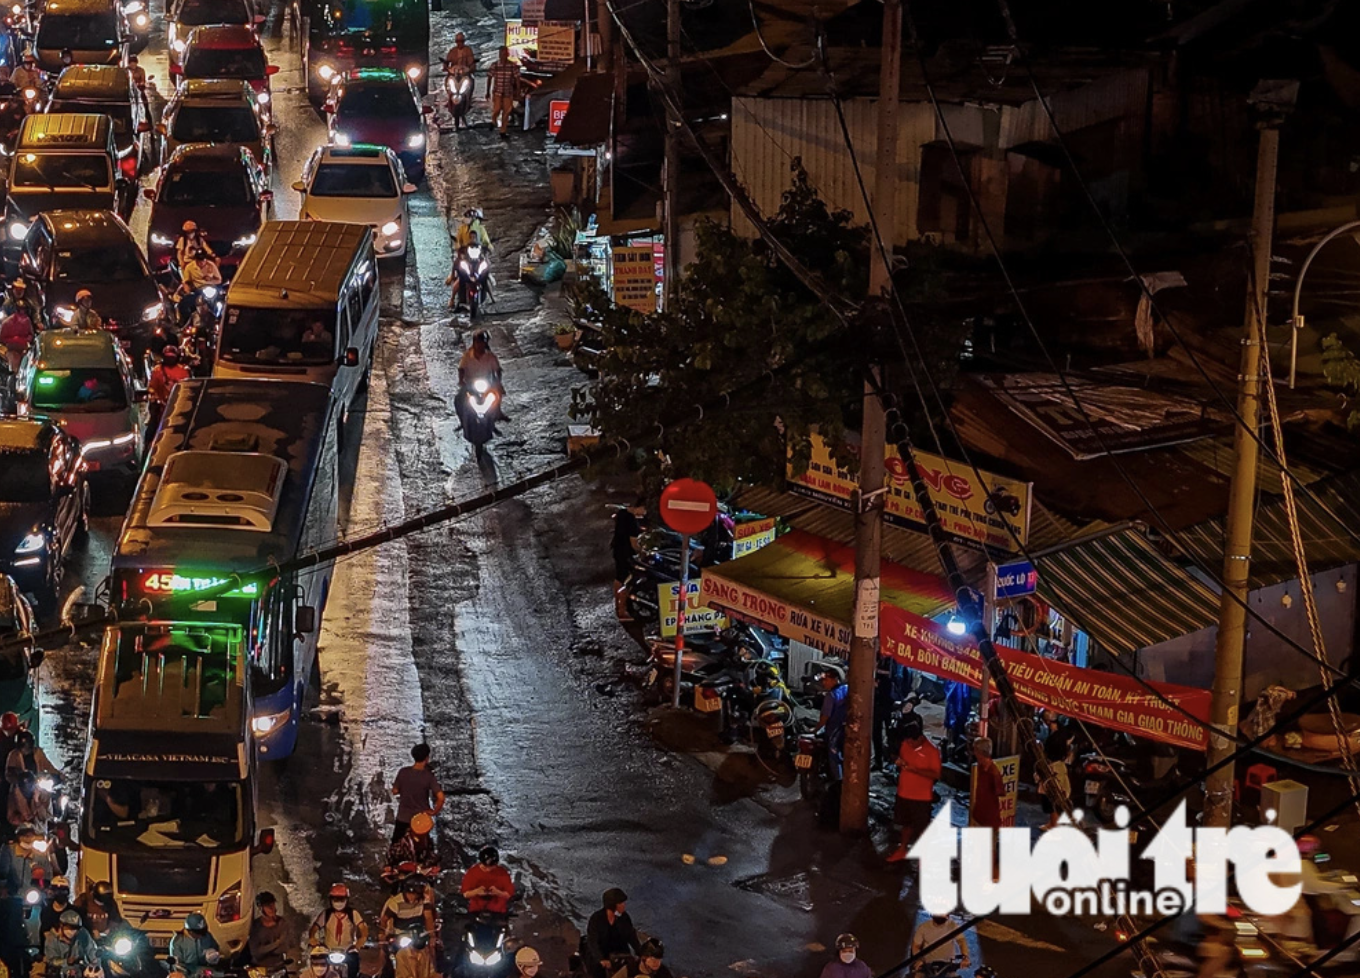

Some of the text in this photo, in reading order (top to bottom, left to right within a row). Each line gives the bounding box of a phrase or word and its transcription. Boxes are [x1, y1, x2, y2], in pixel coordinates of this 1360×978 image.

[144, 573, 173, 590] 45
[702, 577, 739, 604] SANG
[741, 591, 787, 620] TRỌNG
[810, 617, 822, 634] XE
[903, 622, 918, 639] XE
[1006, 657, 1034, 681] TIÊU
[1034, 670, 1072, 693] CHUẨN
[1073, 680, 1091, 697] AN
[1091, 682, 1122, 705] TOÀN,
[897, 643, 915, 663] BA,
[916, 645, 940, 668] BỐN
[940, 653, 972, 677] BÁNH
[1081, 702, 1114, 720] THAM
[1116, 710, 1135, 727] GIA
[1137, 714, 1164, 733] GIAO
[1166, 718, 1204, 742] THÔNG
[161, 753, 209, 764] VIETNAM
[1002, 763, 1016, 777] XE
